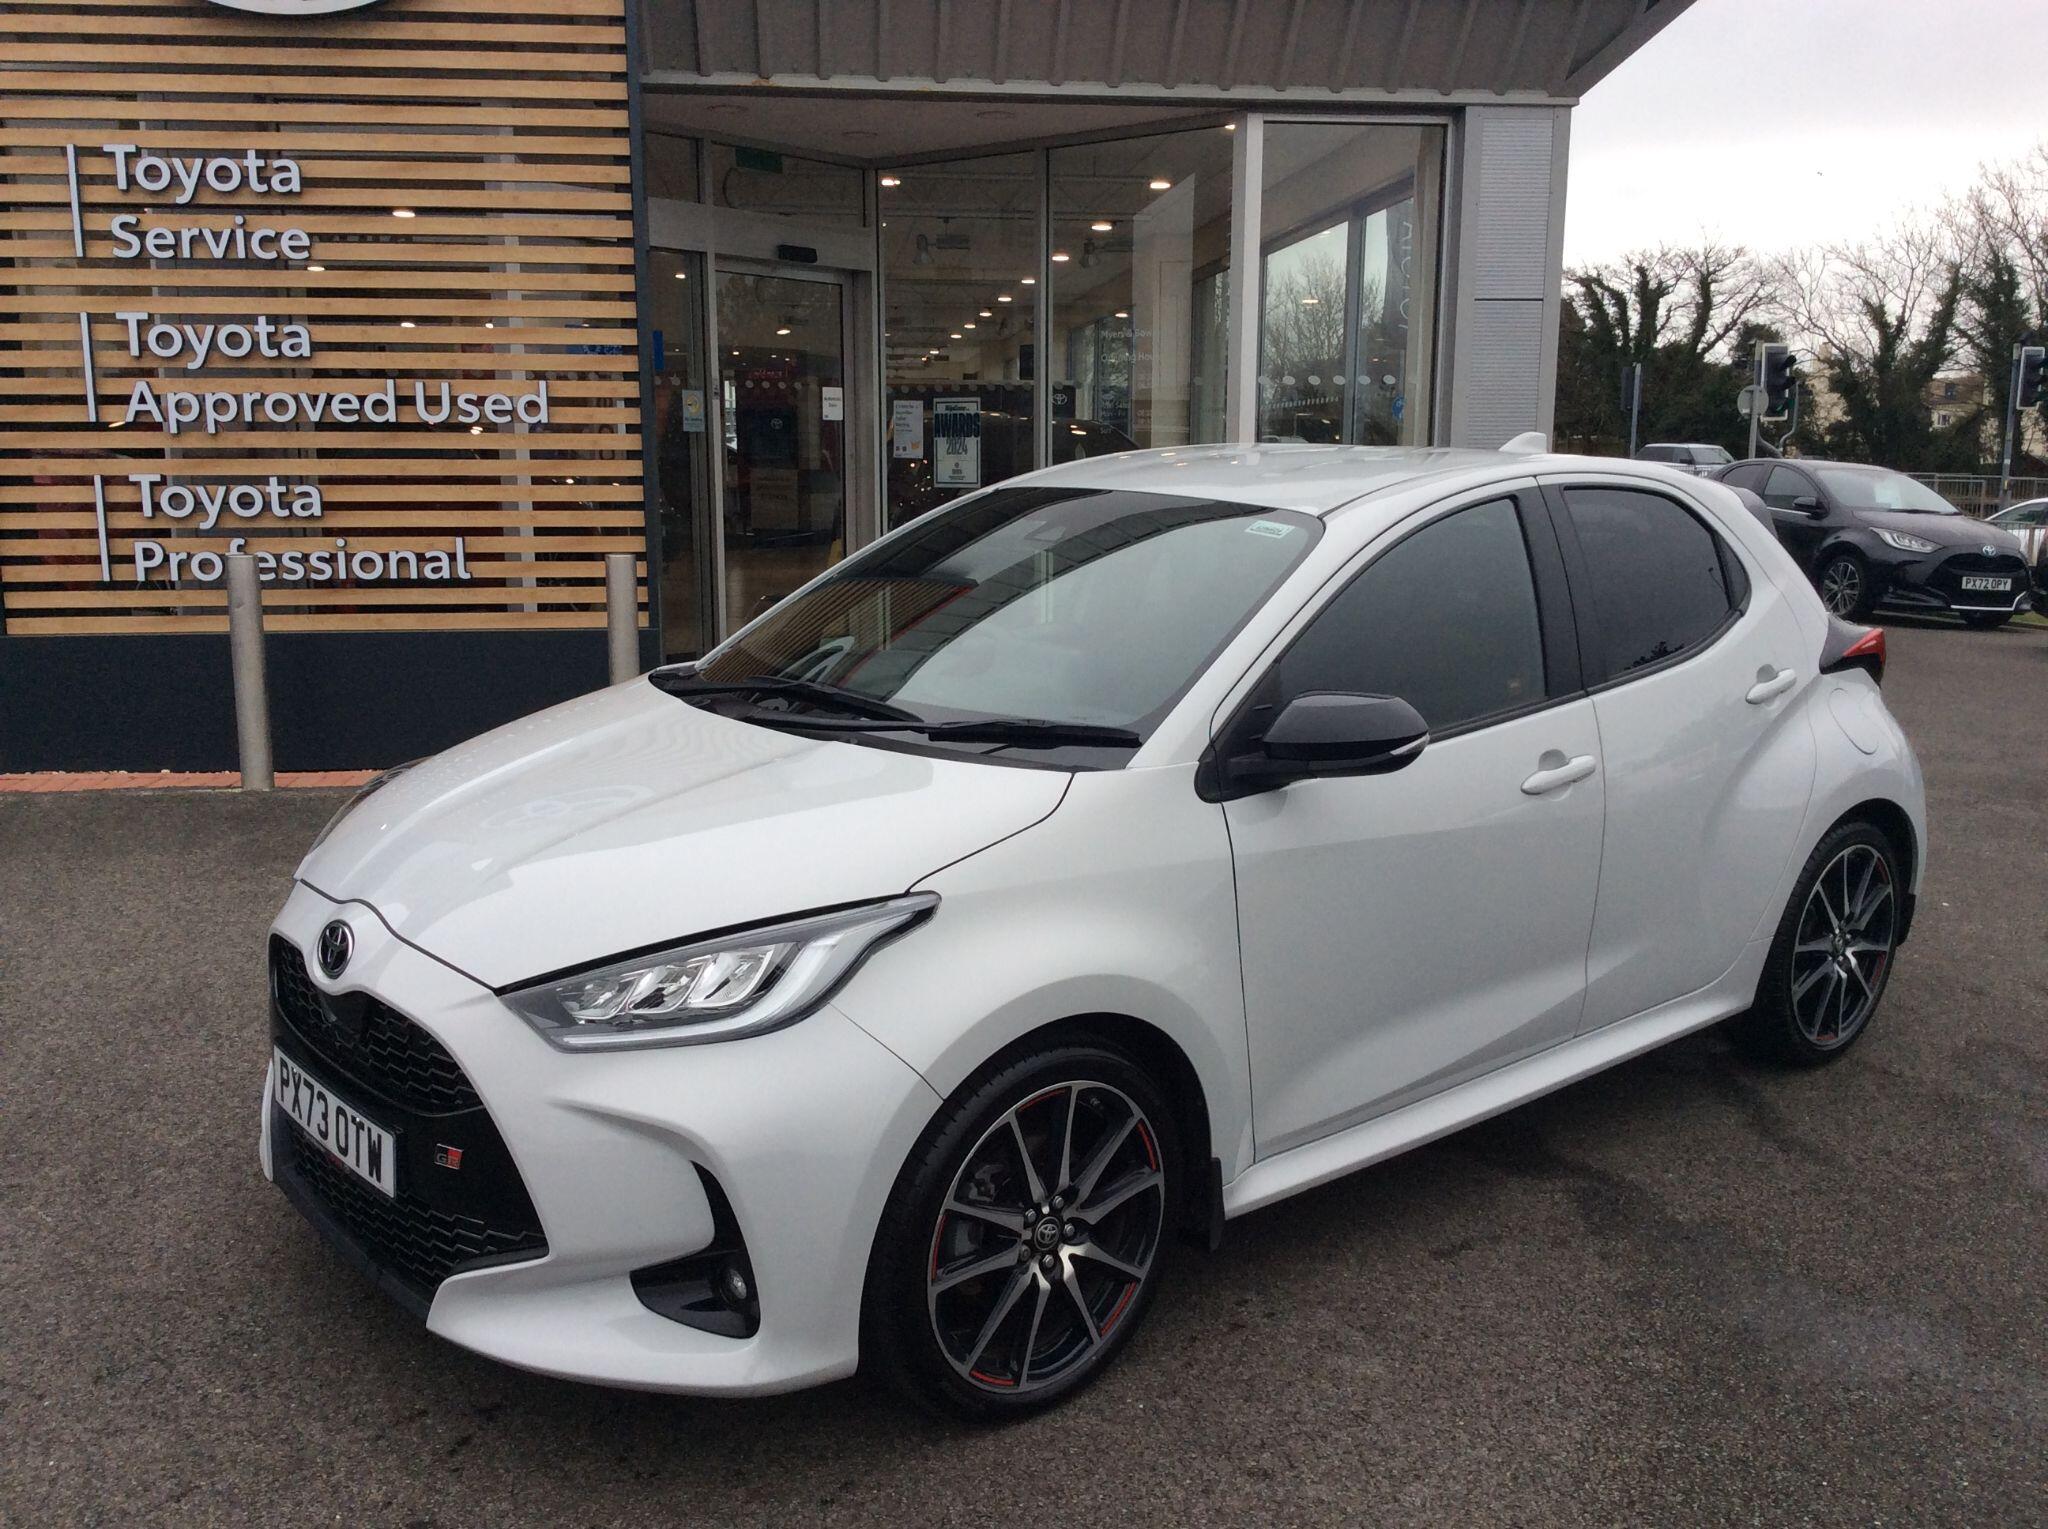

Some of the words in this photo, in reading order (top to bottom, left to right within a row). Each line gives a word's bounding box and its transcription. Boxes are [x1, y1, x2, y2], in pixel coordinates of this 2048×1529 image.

[103, 143, 302, 204] Toyota
[110, 214, 311, 261] Service
[116, 311, 312, 369] Toyota
[125, 379, 397, 434] Approved
[414, 380, 550, 425] Used
[934, 413, 980, 438] AWARDS
[946, 437, 968, 455] 2024
[129, 474, 323, 529] Toyota
[133, 536, 472, 582] Professional
[1966, 578, 1989, 589] PX72
[1991, 579, 2008, 590] OPY
[280, 1056, 329, 1141] PX73
[335, 1105, 382, 1184] OTW
